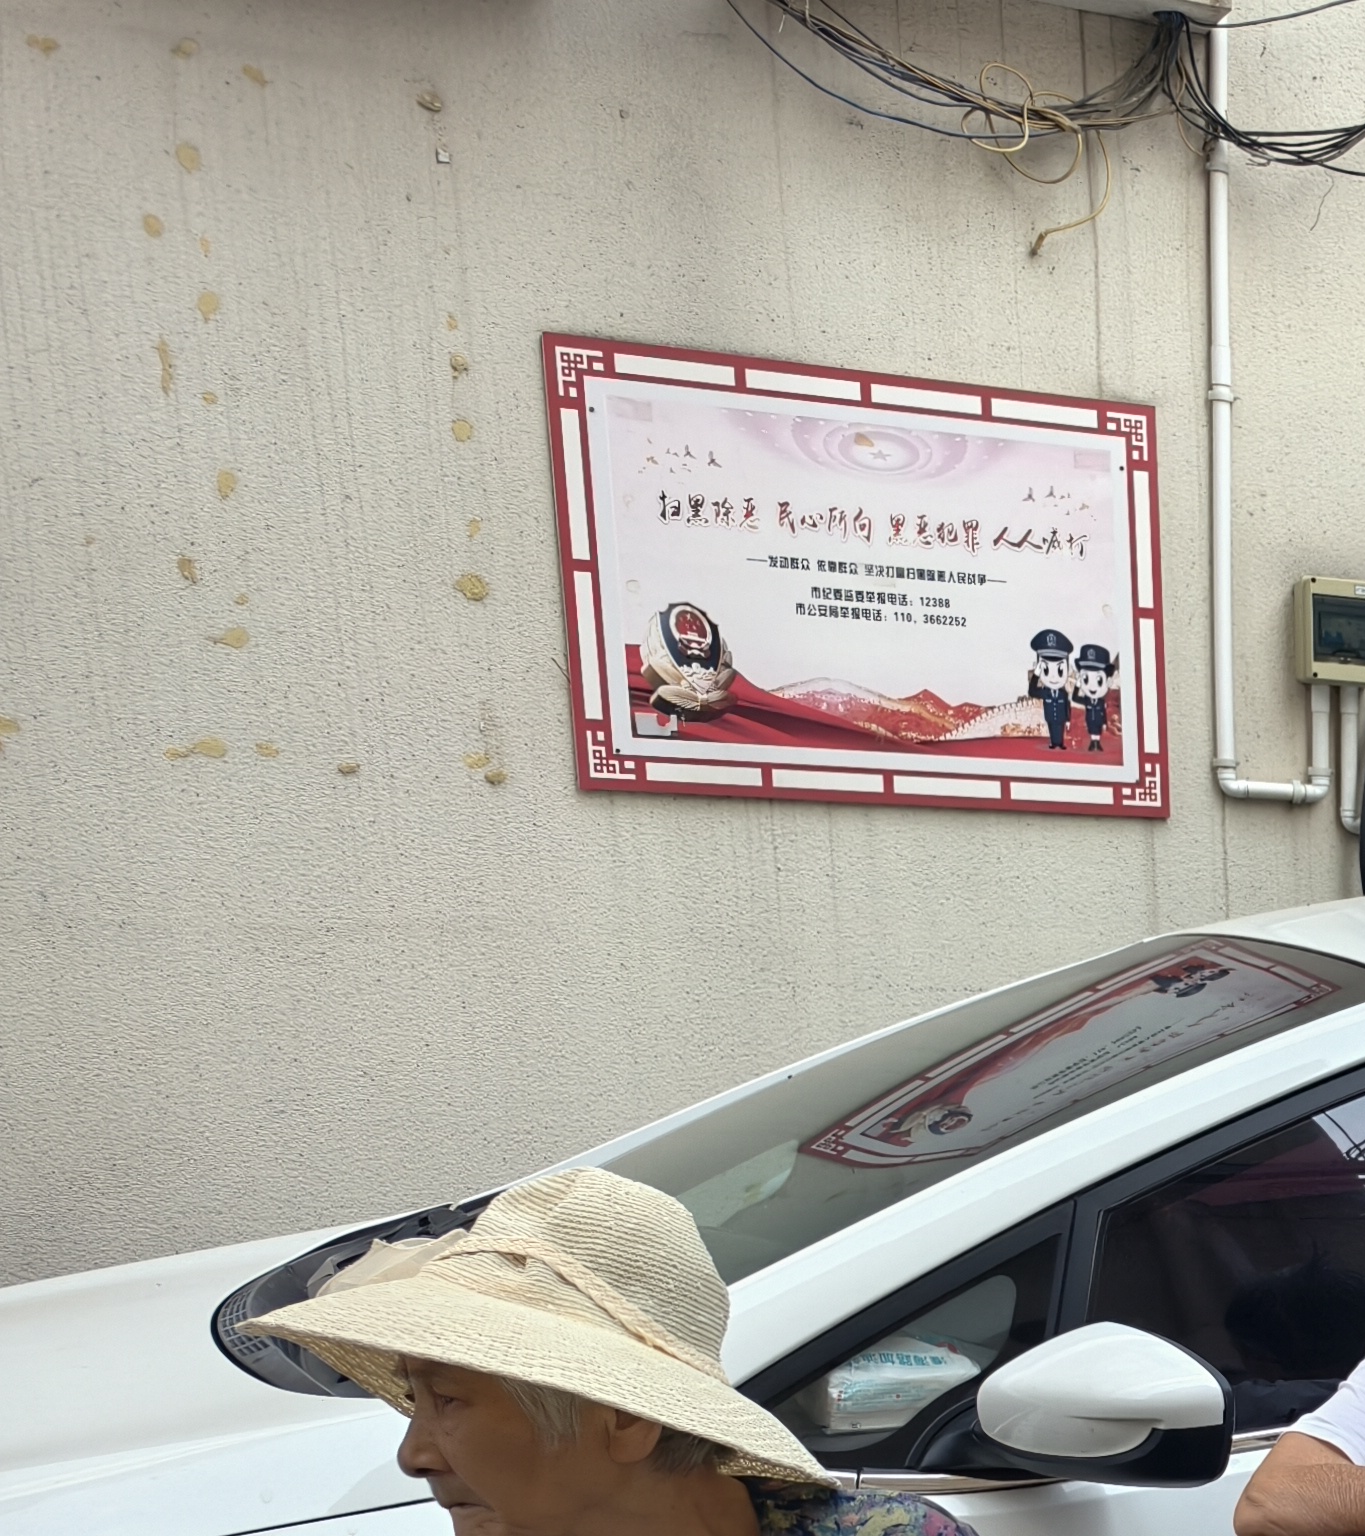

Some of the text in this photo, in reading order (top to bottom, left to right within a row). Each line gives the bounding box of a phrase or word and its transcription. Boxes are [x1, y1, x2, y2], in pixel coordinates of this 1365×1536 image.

[656, 489, 1089, 558] 扫黑除恶 民心所向 黑恶犯罪 人人喊打
